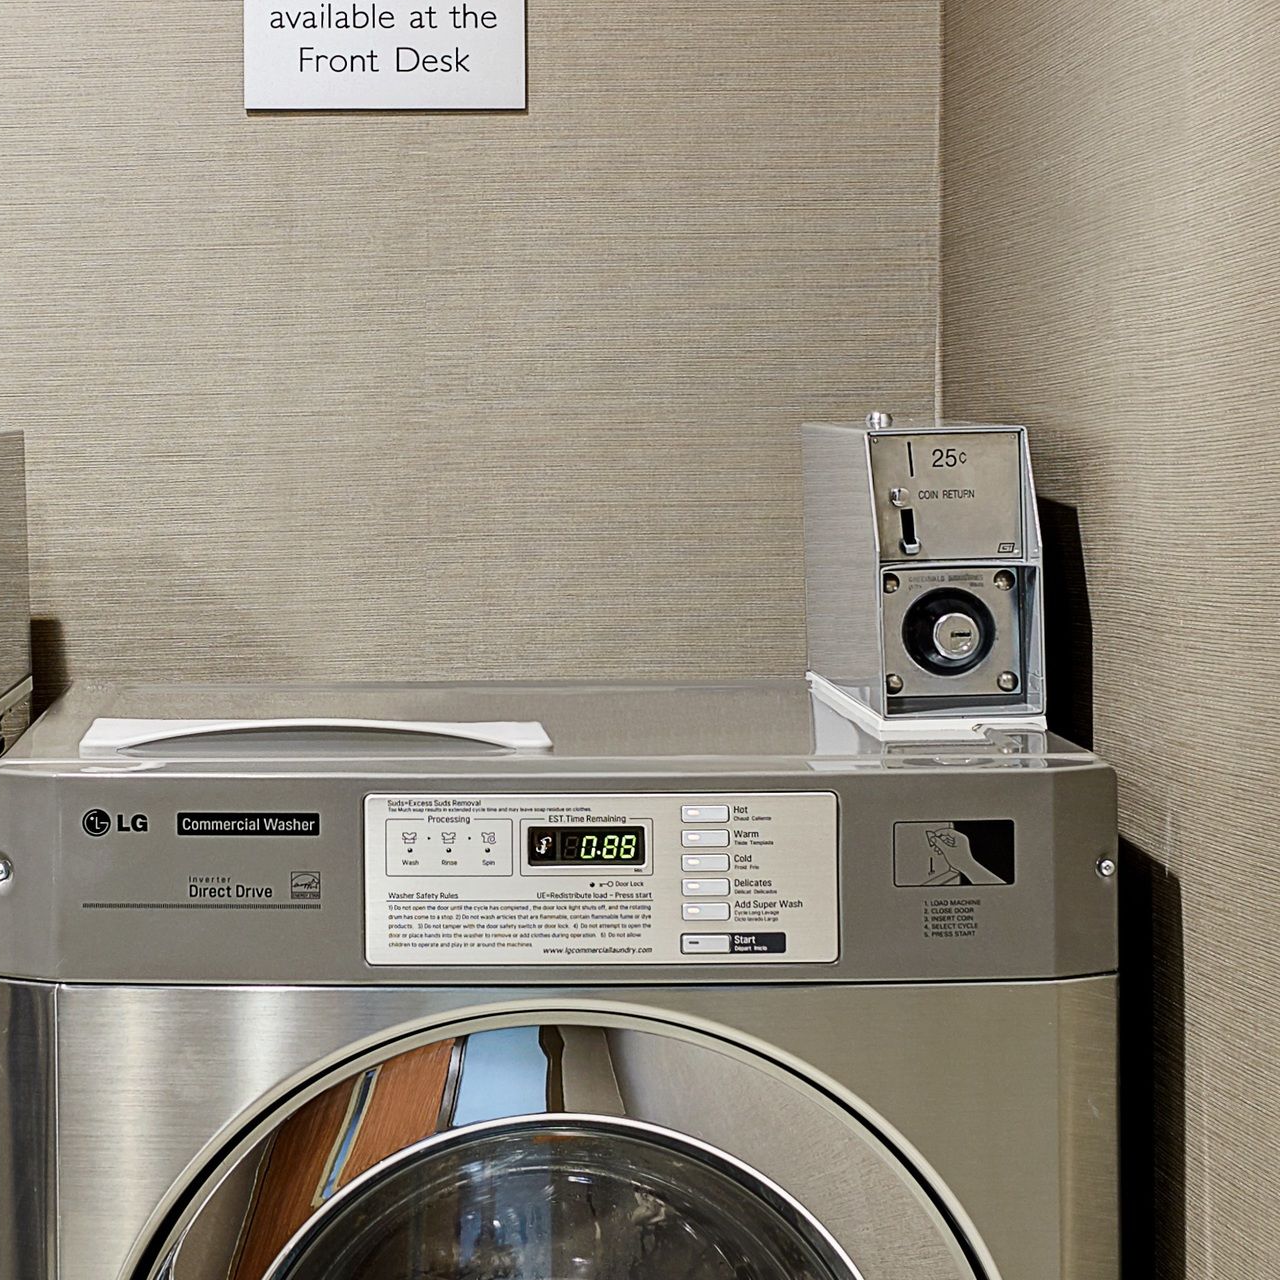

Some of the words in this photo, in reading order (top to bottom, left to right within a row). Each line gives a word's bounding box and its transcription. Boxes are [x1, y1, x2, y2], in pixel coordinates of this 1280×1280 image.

[270, 3, 395, 29] available
[410, 6, 438, 29] at
[449, 3, 497, 29] the
[300, 47, 379, 72] Front
[396, 47, 470, 72] Desk
[918, 490, 938, 500] COIN
[942, 489, 975, 499] RETURN
[434, 799, 451, 807] Suds
[452, 799, 481, 807] Removal
[733, 806, 748, 814] Hot
[117, 814, 148, 832] LG
[428, 815, 470, 824] Processing
[586, 815, 626, 824] Remaining
[182, 818, 260, 831] Commercial
[263, 818, 315, 831] Washer
[733, 830, 759, 838] Warm
[734, 854, 752, 863] Cold
[615, 880, 629, 888] Door
[630, 880, 644, 888] Lock
[734, 879, 772, 887] Delicates
[189, 884, 232, 898] Direct
[236, 885, 272, 898] Drive
[388, 892, 414, 900] Washer
[734, 900, 751, 908] Add
[753, 900, 777, 909] Super
[779, 900, 803, 908] Wash
[931, 907, 952, 915] CLOSE
[956, 914, 974, 922] COIN
[957, 922, 978, 930] CYCLE
[734, 935, 755, 944] Start
